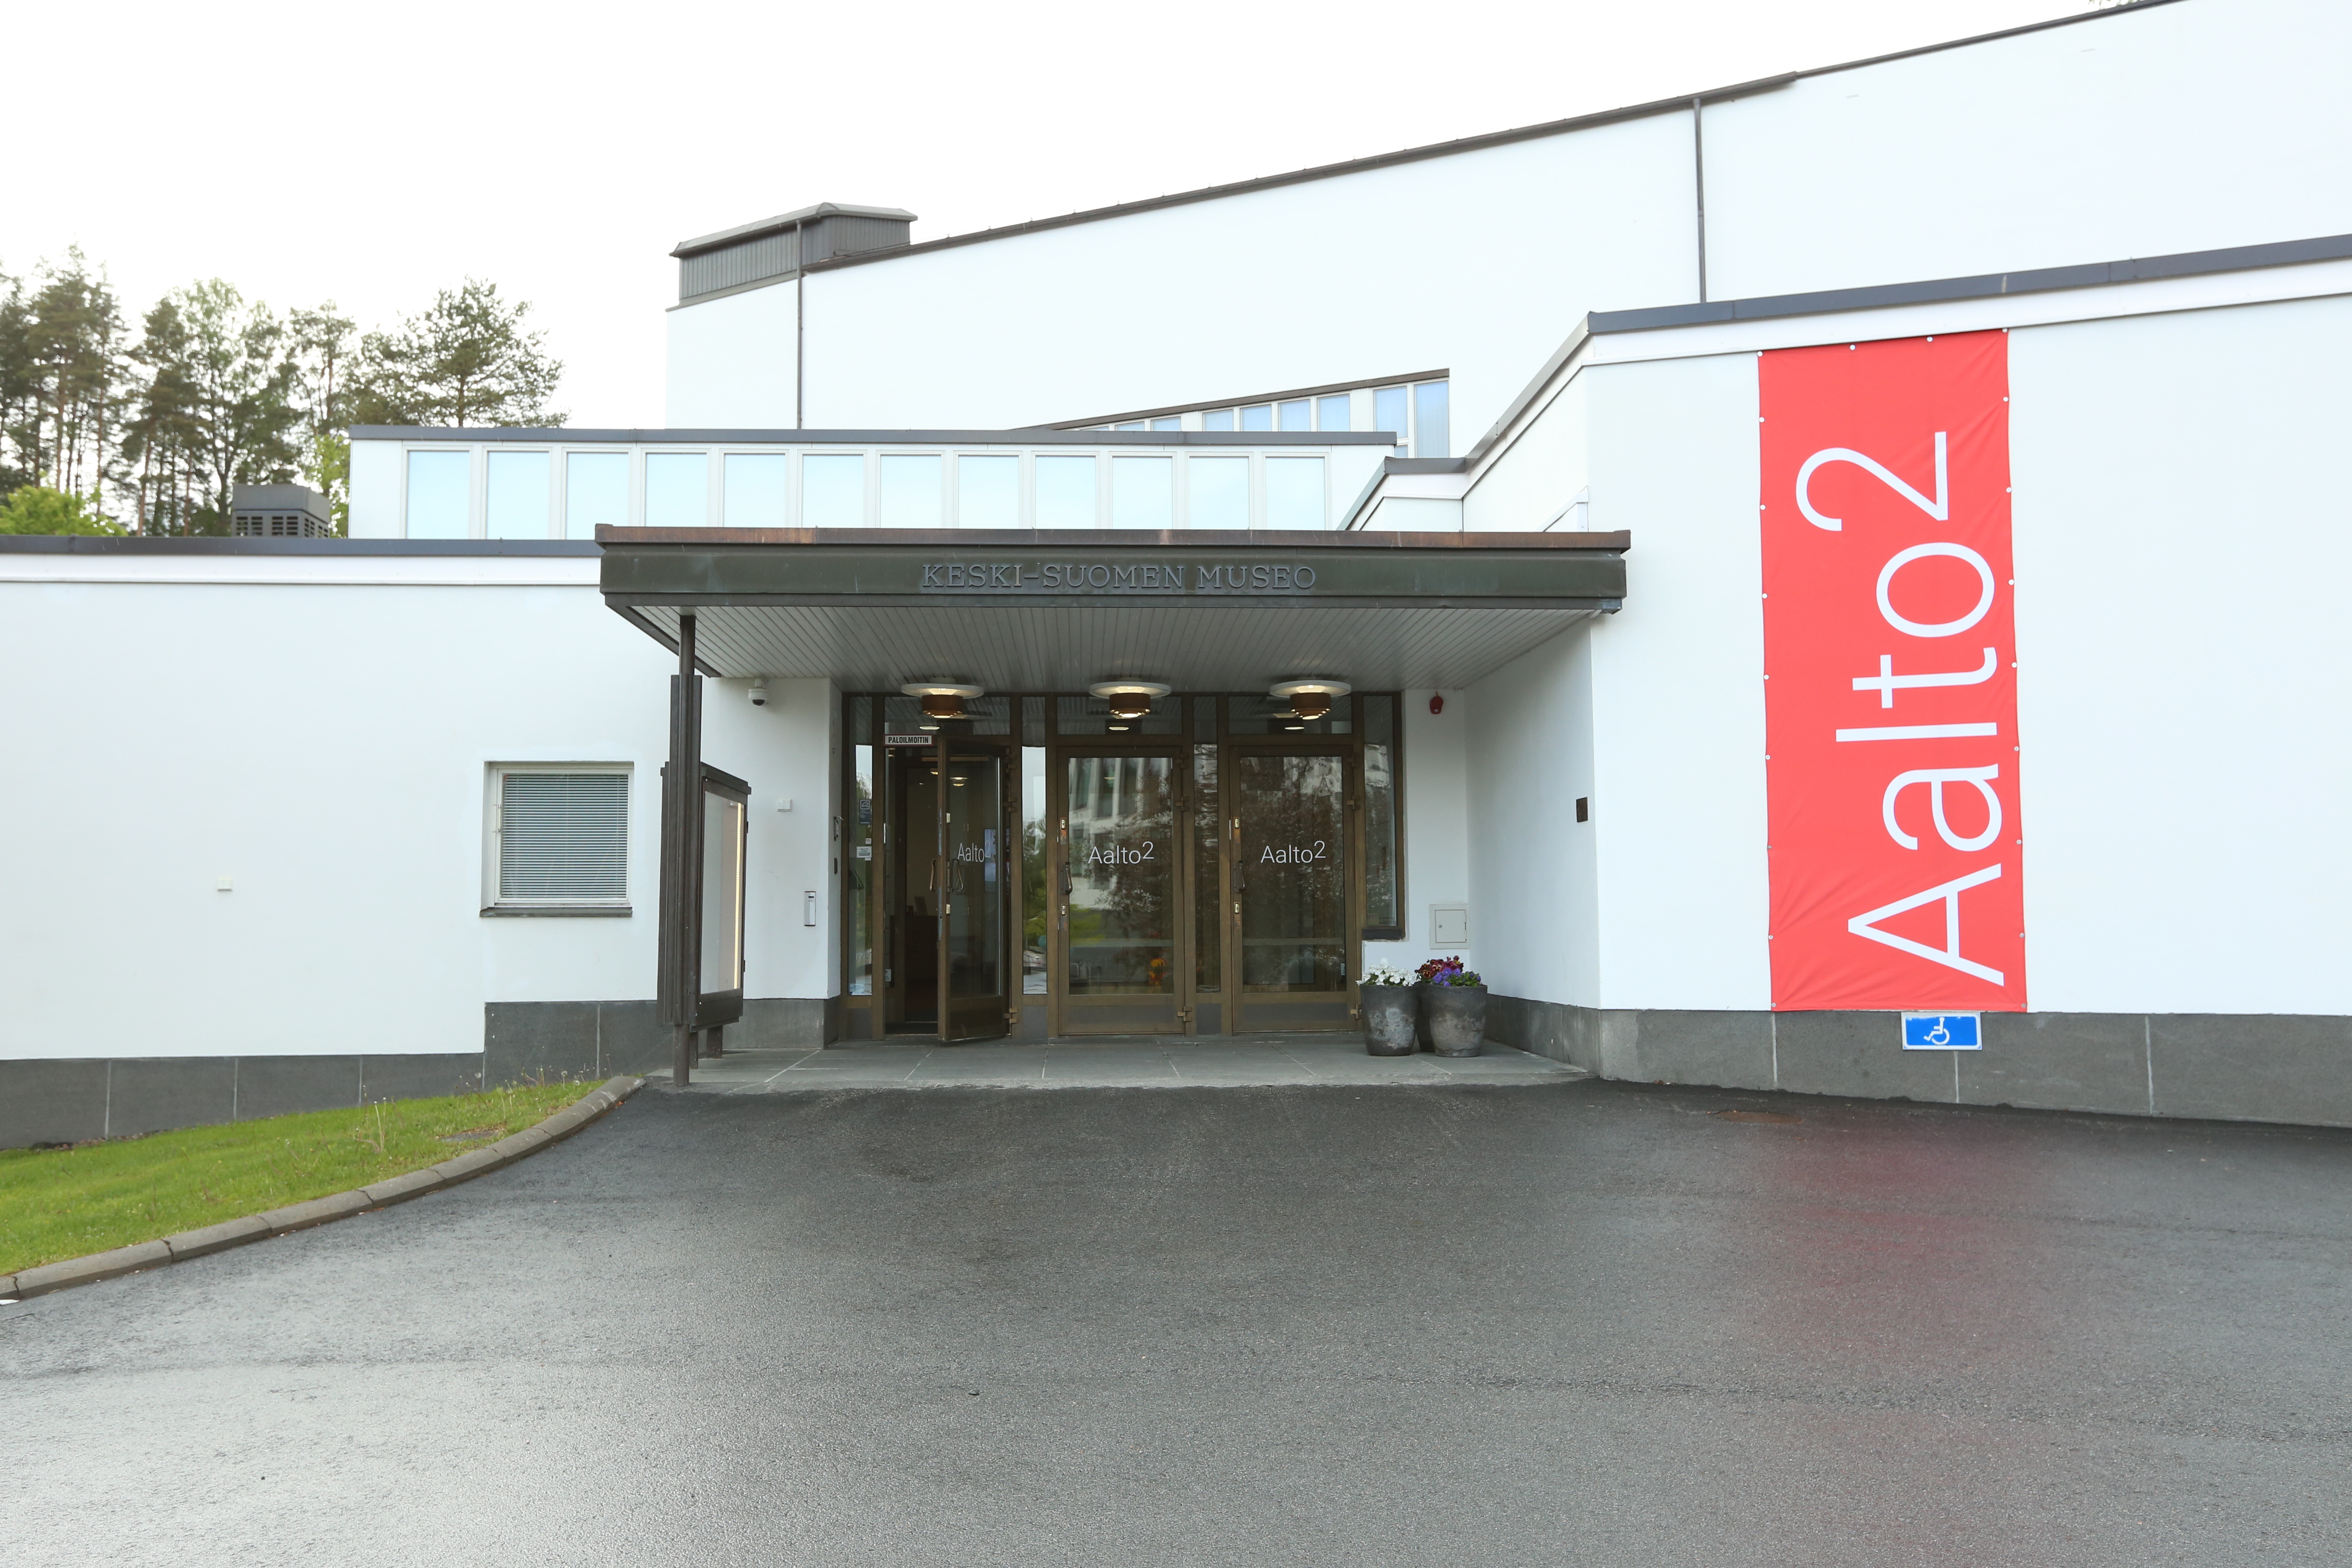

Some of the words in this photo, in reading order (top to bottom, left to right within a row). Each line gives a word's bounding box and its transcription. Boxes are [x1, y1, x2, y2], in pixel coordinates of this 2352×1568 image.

[922, 564, 1185, 588] KESKI-SUOMEN
[1198, 565, 1316, 589] MUSEO
[1795, 431, 2004, 987] Aalto2
[1088, 841, 1155, 864] Aalto2
[1260, 840, 1326, 863] Aalto2
